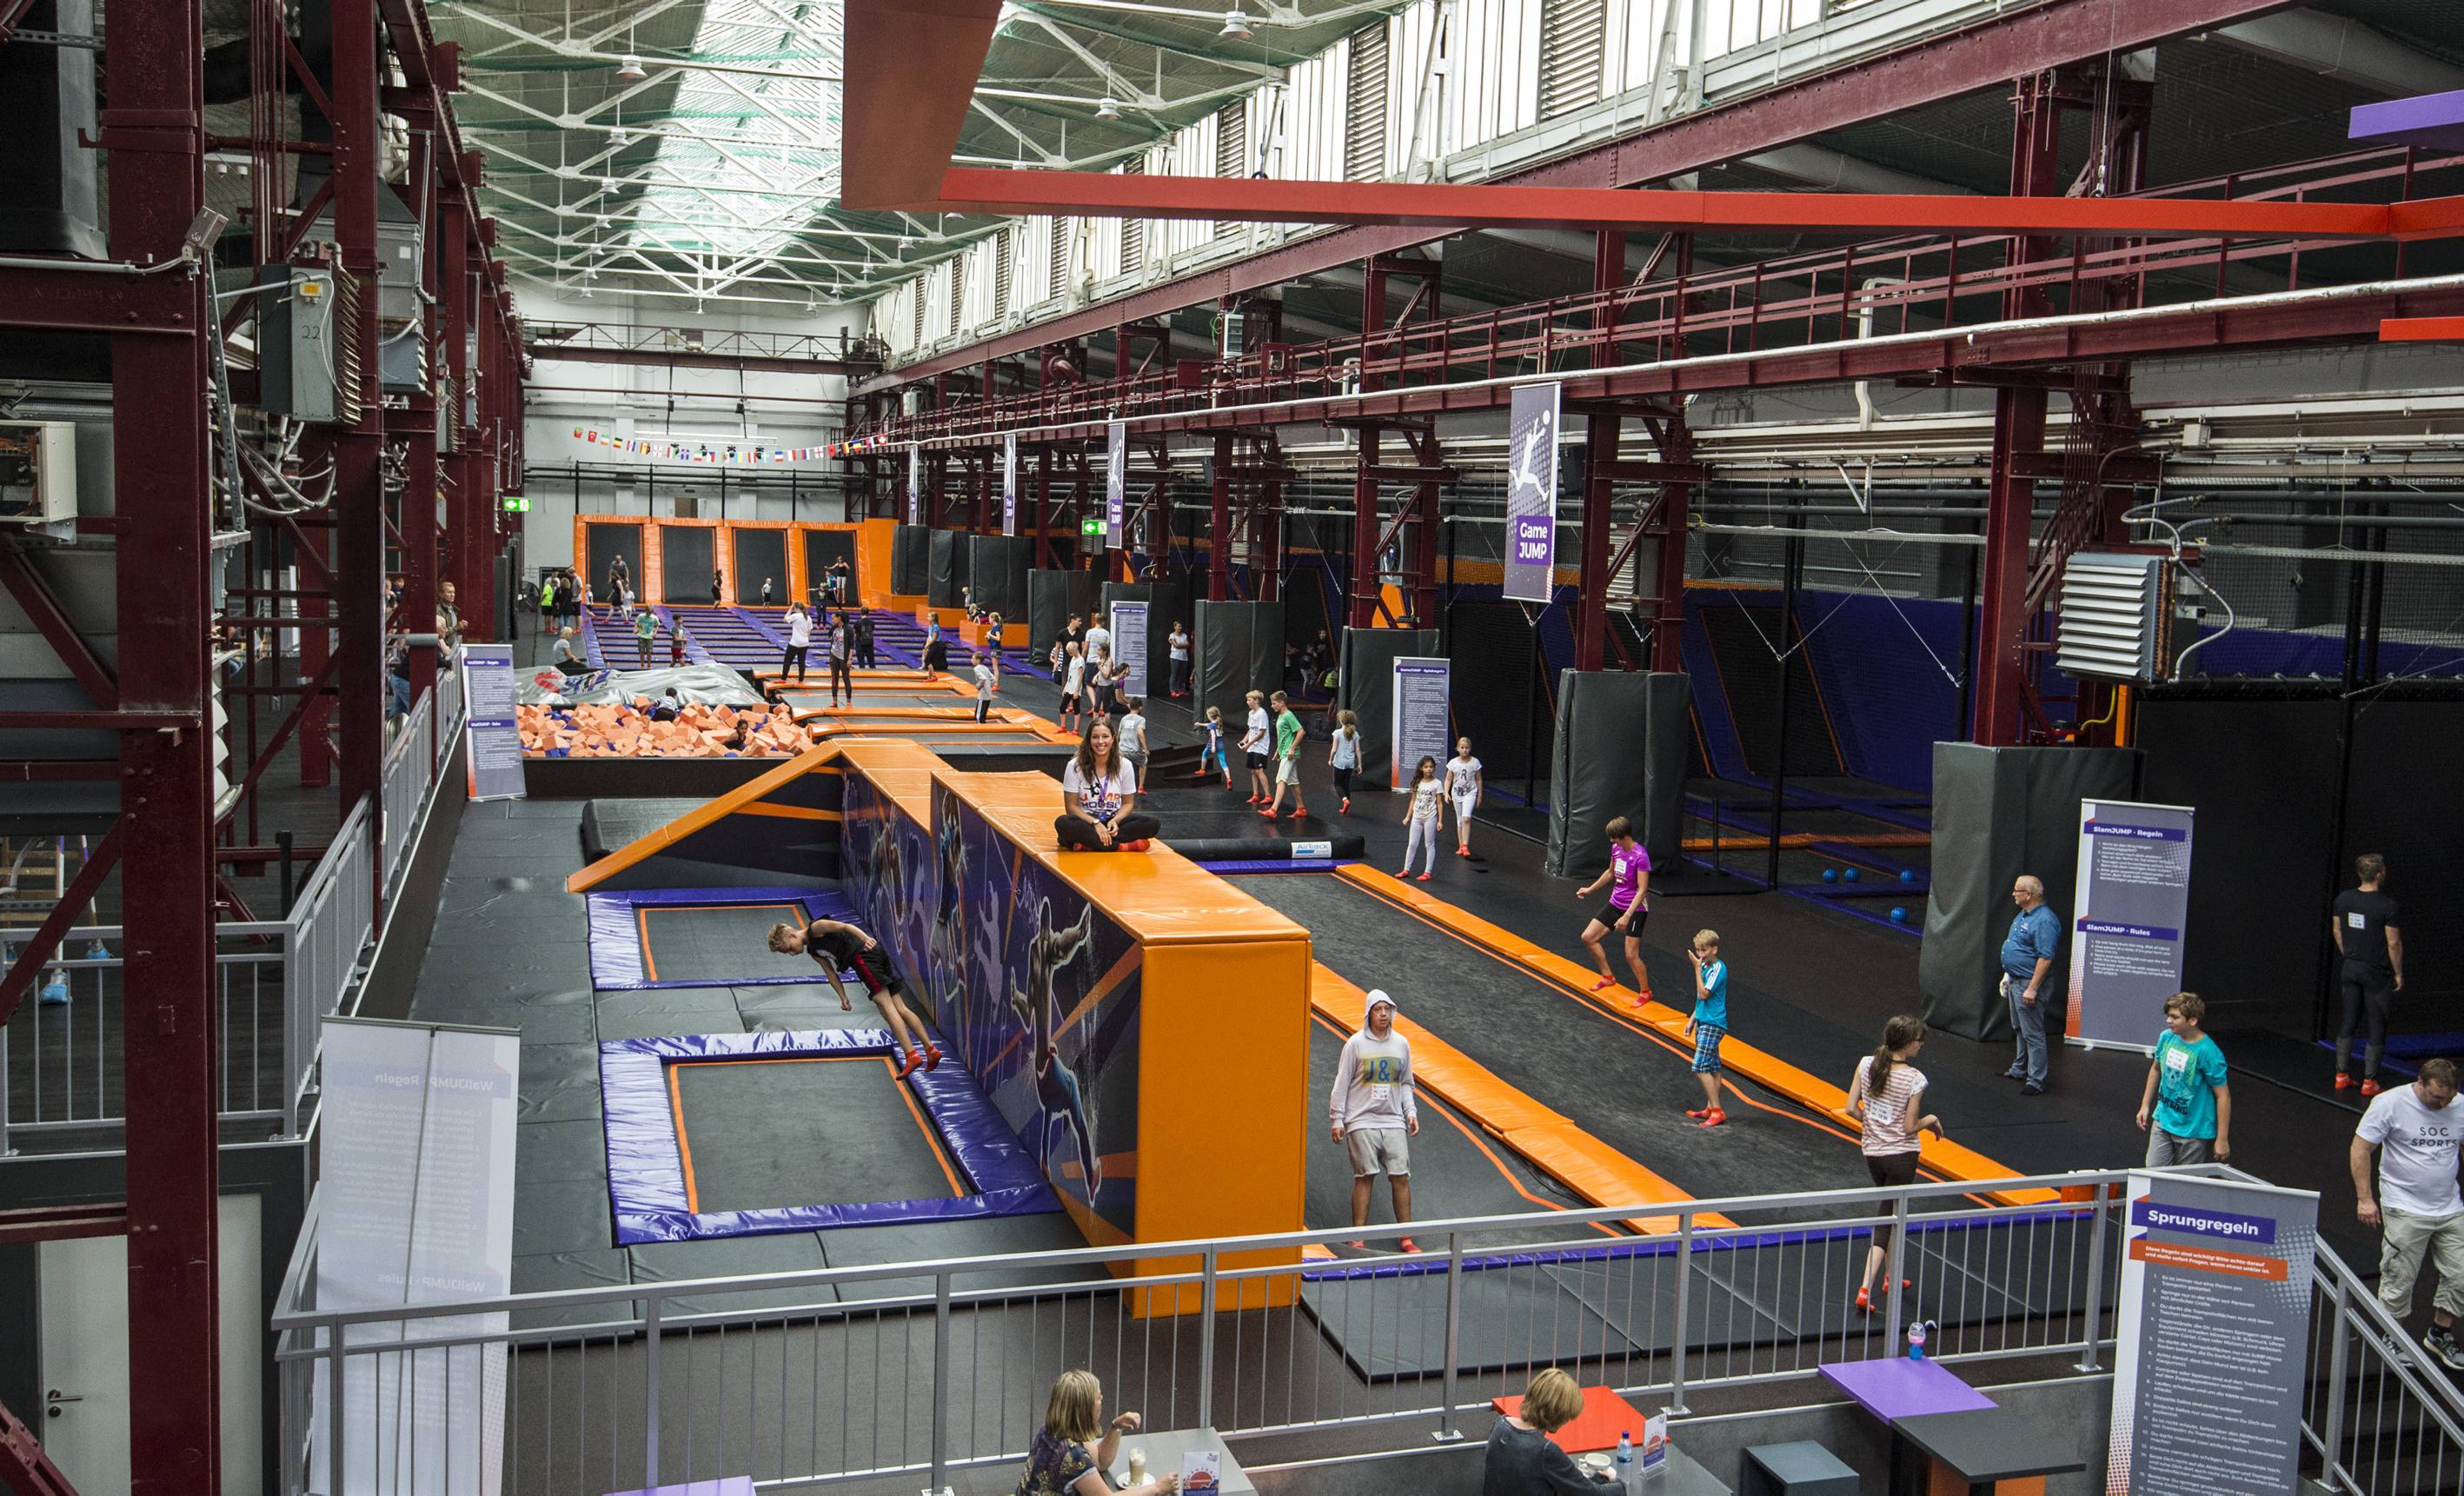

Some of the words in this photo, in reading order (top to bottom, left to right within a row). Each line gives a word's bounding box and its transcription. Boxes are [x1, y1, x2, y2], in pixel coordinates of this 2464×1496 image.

[302, 326, 321, 340] 22
[1520, 522, 1547, 539] Game
[1519, 542, 1547, 559] JUMP
[2093, 826, 2132, 836] SlamJUMP
[2137, 829, 2163, 839] Regeln
[2086, 924, 2125, 934] SlamJUMP
[2130, 928, 2150, 936] Rules
[2420, 1127, 2449, 1136] SOC
[2148, 1210, 2258, 1235] Sprungregeln
[2193, 1252, 2214, 1261] wichtig!
